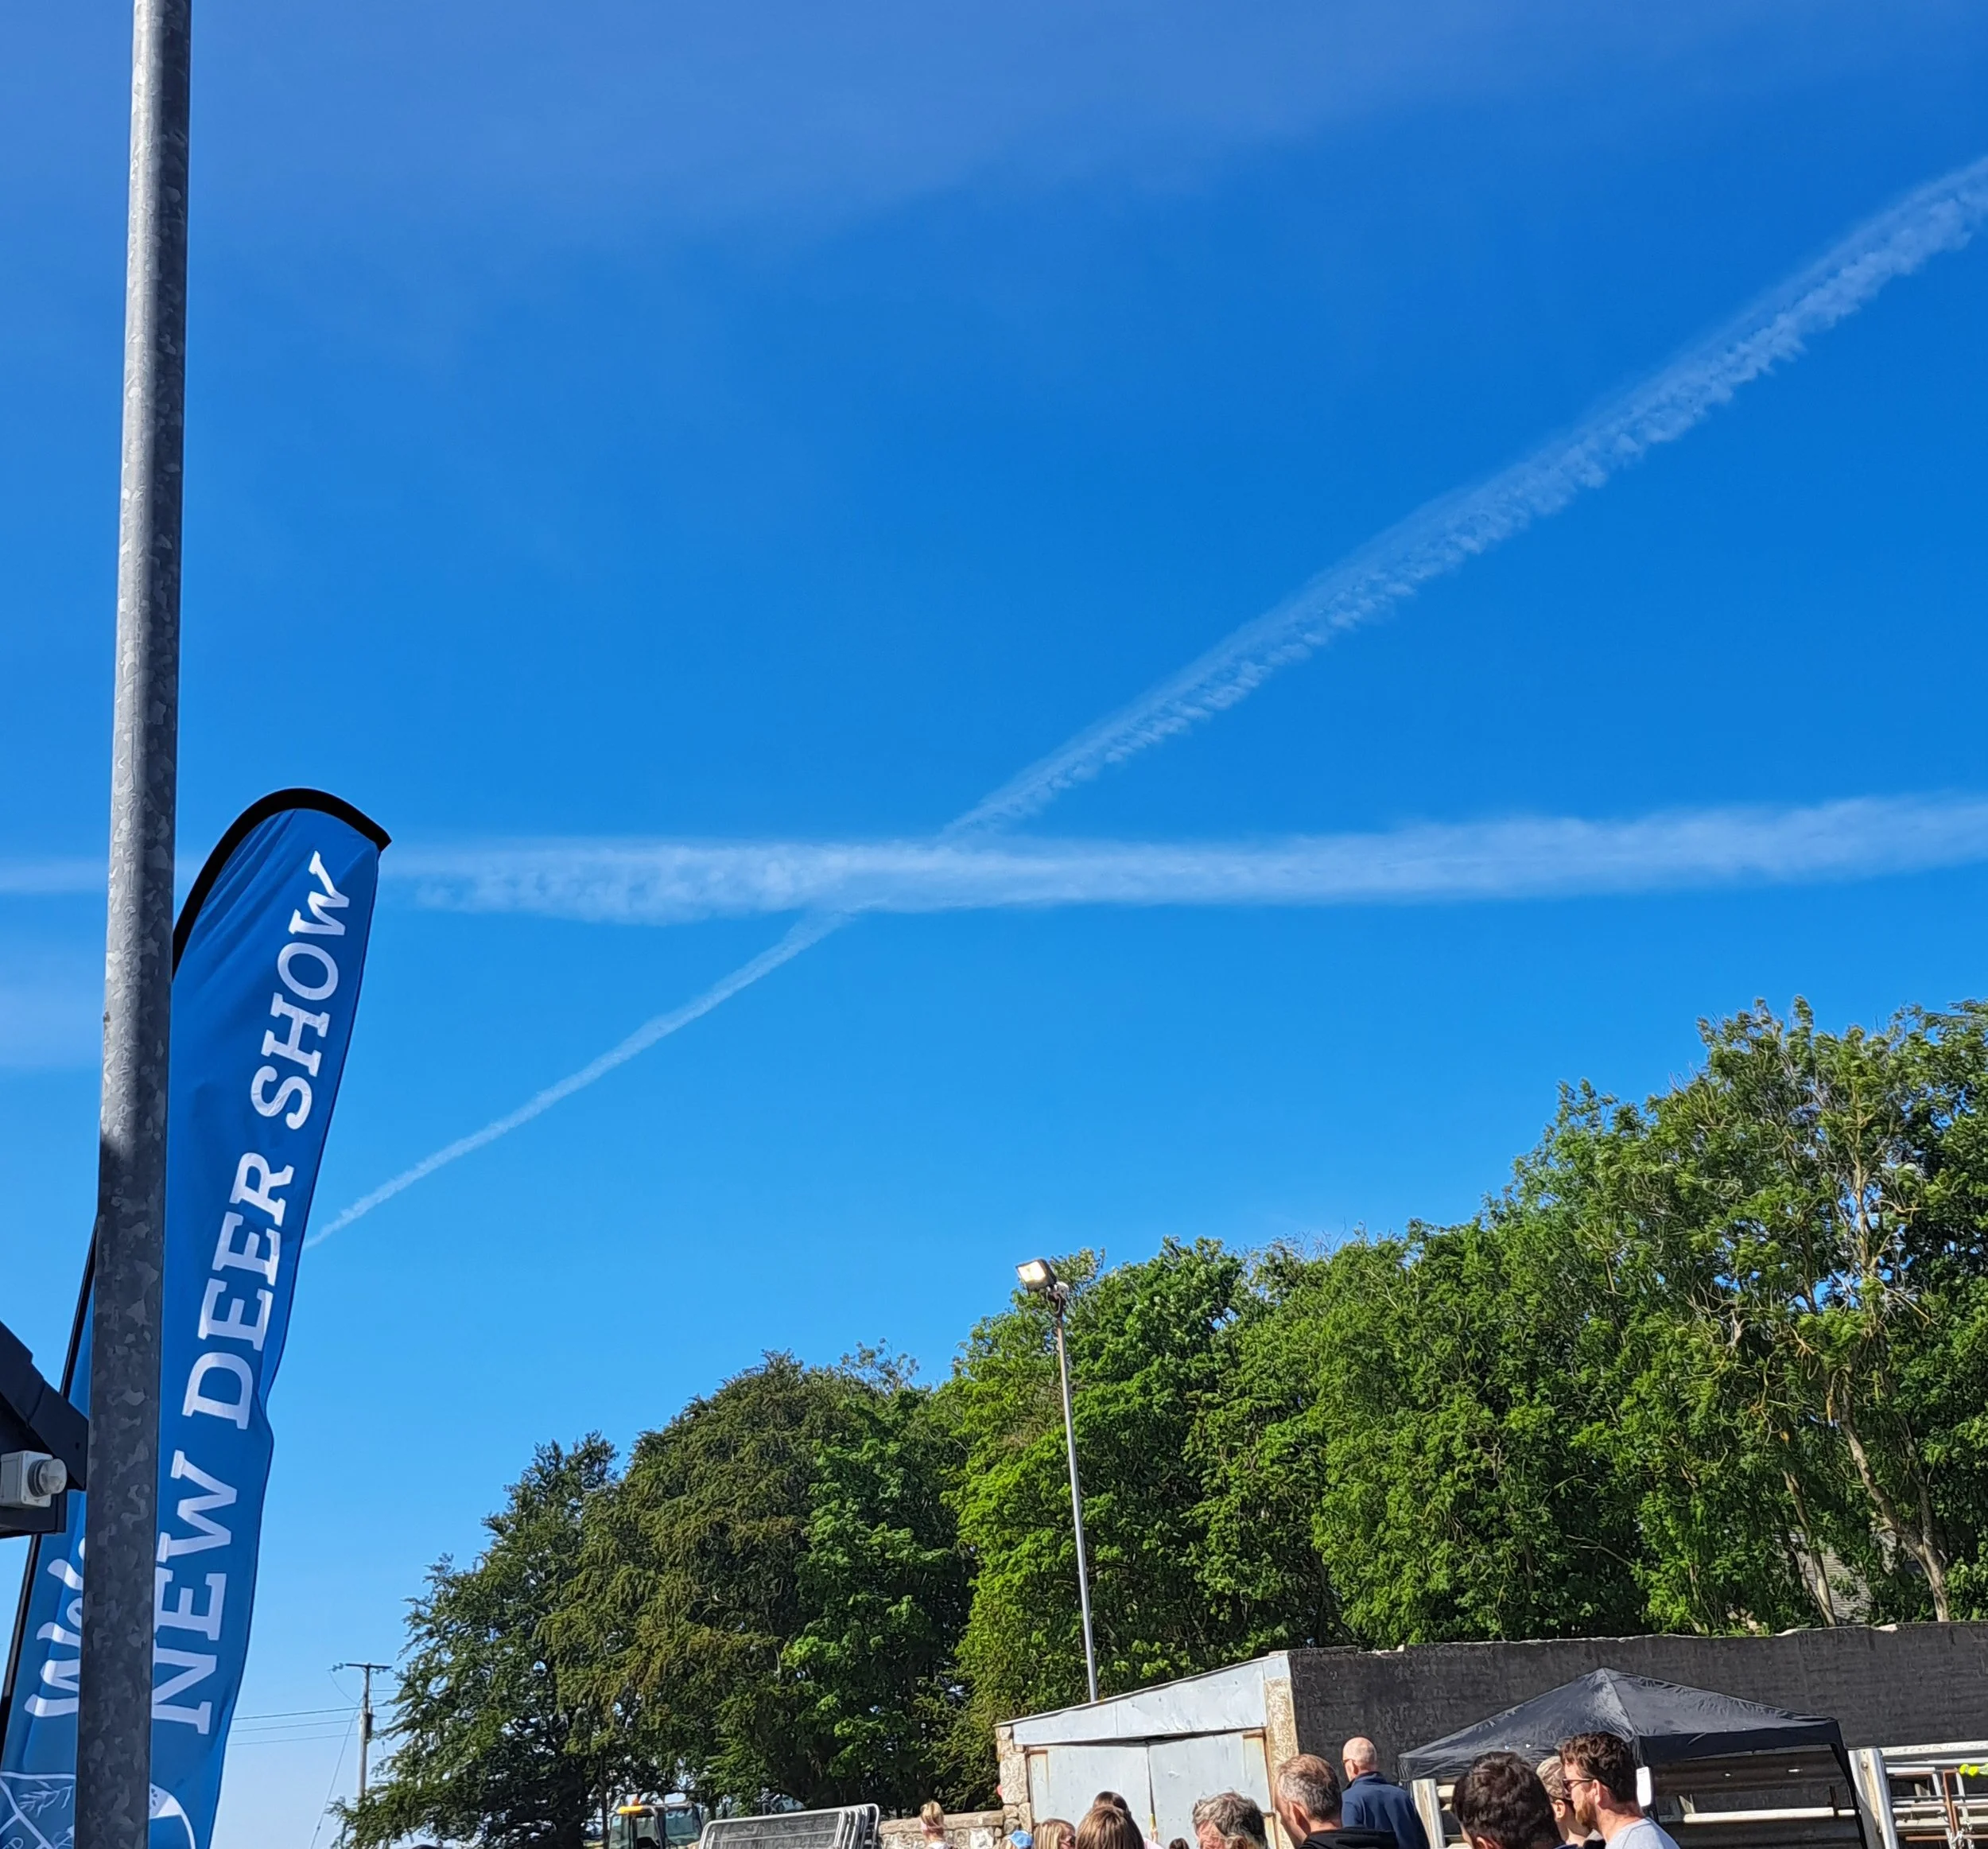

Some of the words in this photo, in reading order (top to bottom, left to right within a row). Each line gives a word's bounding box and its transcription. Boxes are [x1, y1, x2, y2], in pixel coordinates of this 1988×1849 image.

[250, 851, 351, 1130] SHOW
[182, 1152, 293, 1429] DEER
[152, 1450, 237, 1735] NEW
